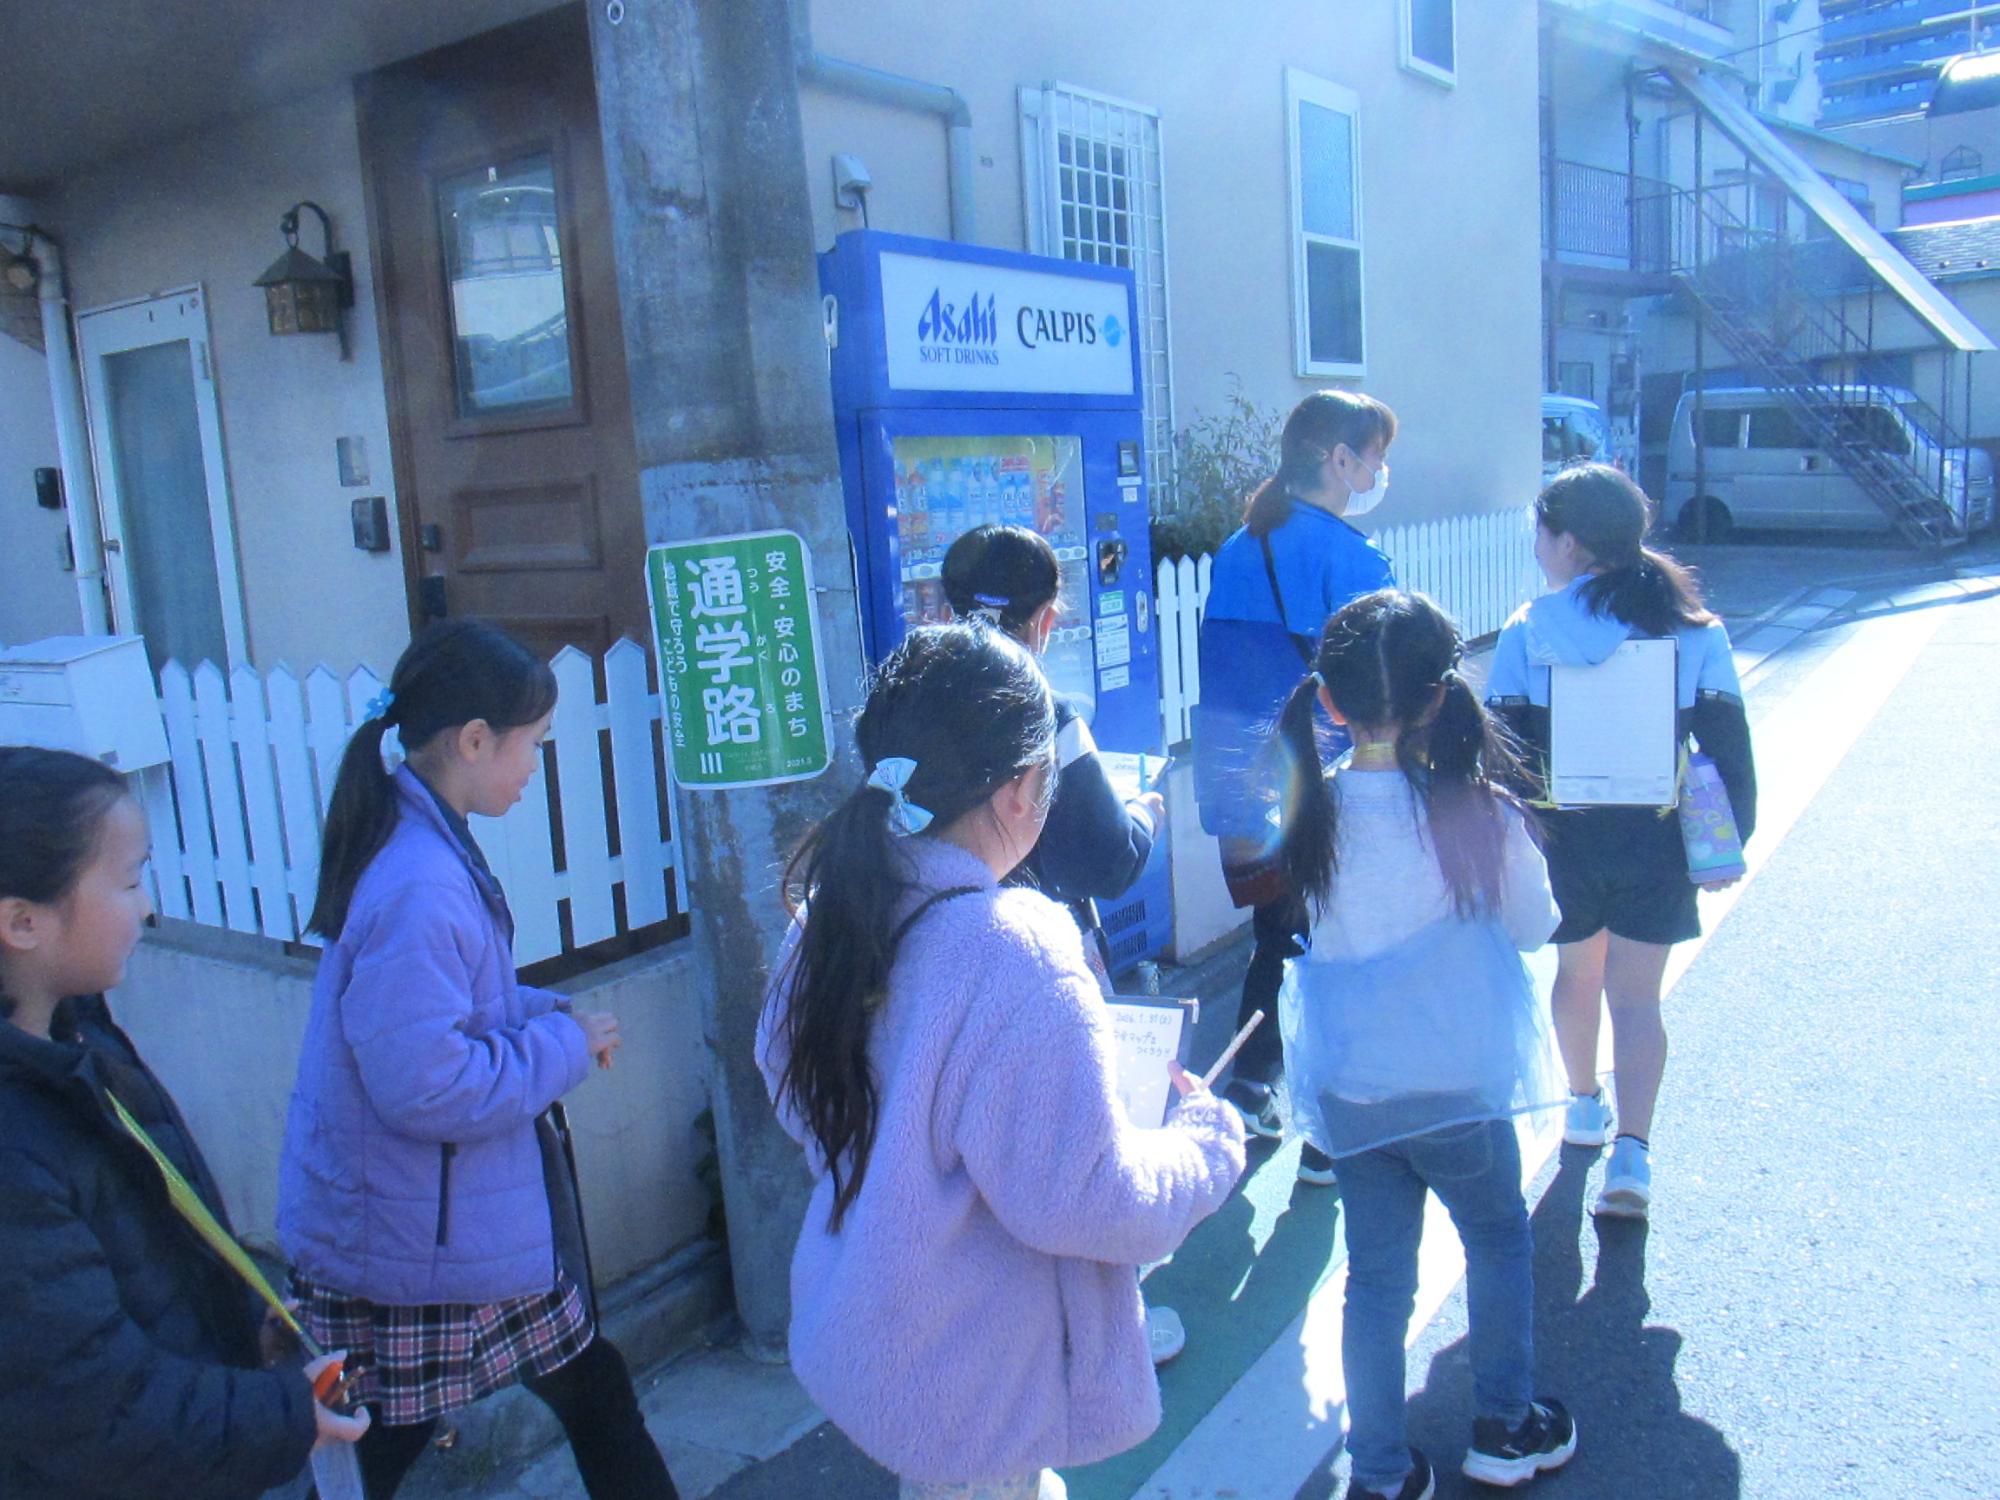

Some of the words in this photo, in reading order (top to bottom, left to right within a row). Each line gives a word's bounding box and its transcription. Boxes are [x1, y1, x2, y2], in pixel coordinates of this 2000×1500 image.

[918, 286, 997, 347] Asahi
[1017, 306, 1096, 349] CALPIS
[920, 346, 951, 364] SOFT
[955, 348, 999, 366] DRINKS
[684, 556, 761, 745] 通学路
[765, 550, 808, 738] 安全・安心のまち
